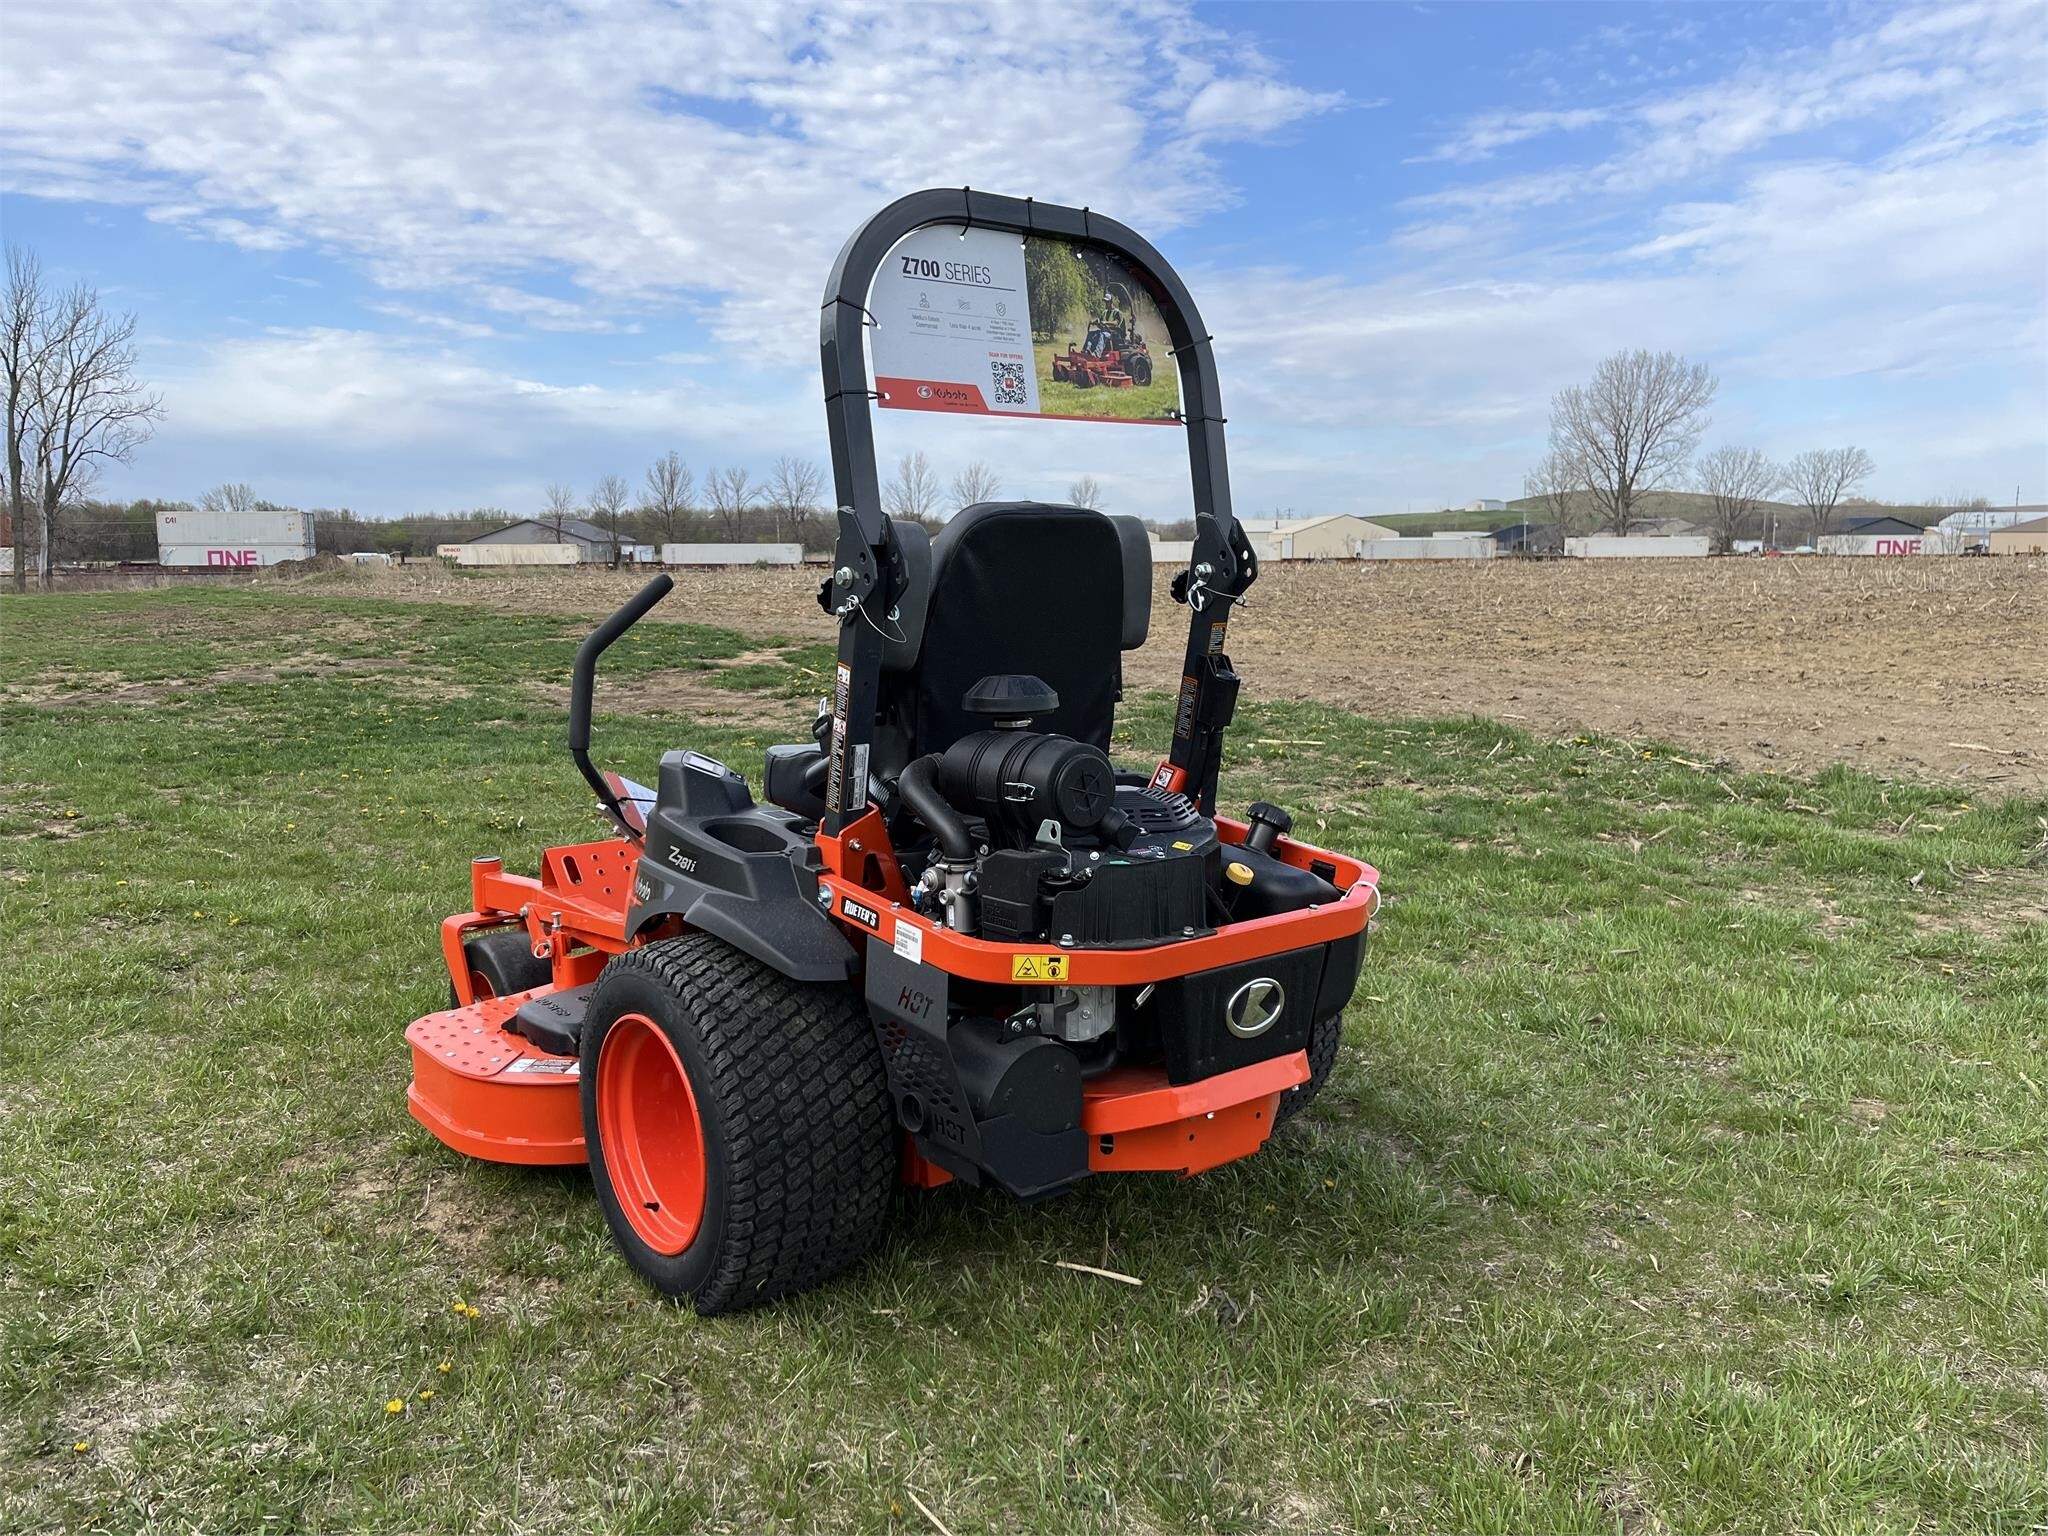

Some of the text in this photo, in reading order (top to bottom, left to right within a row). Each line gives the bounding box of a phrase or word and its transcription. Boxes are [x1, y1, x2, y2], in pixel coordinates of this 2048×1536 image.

[901, 256, 991, 284] Z700 SERIES
[933, 387, 968, 400] Kubota
[207, 550, 258, 566] ONE
[1876, 540, 1922, 555] ONE
[668, 845, 697, 872] Z781i
[844, 899, 877, 927] RUETER'S
[897, 985, 934, 1019] HOT
[934, 1112, 967, 1145] HOT
